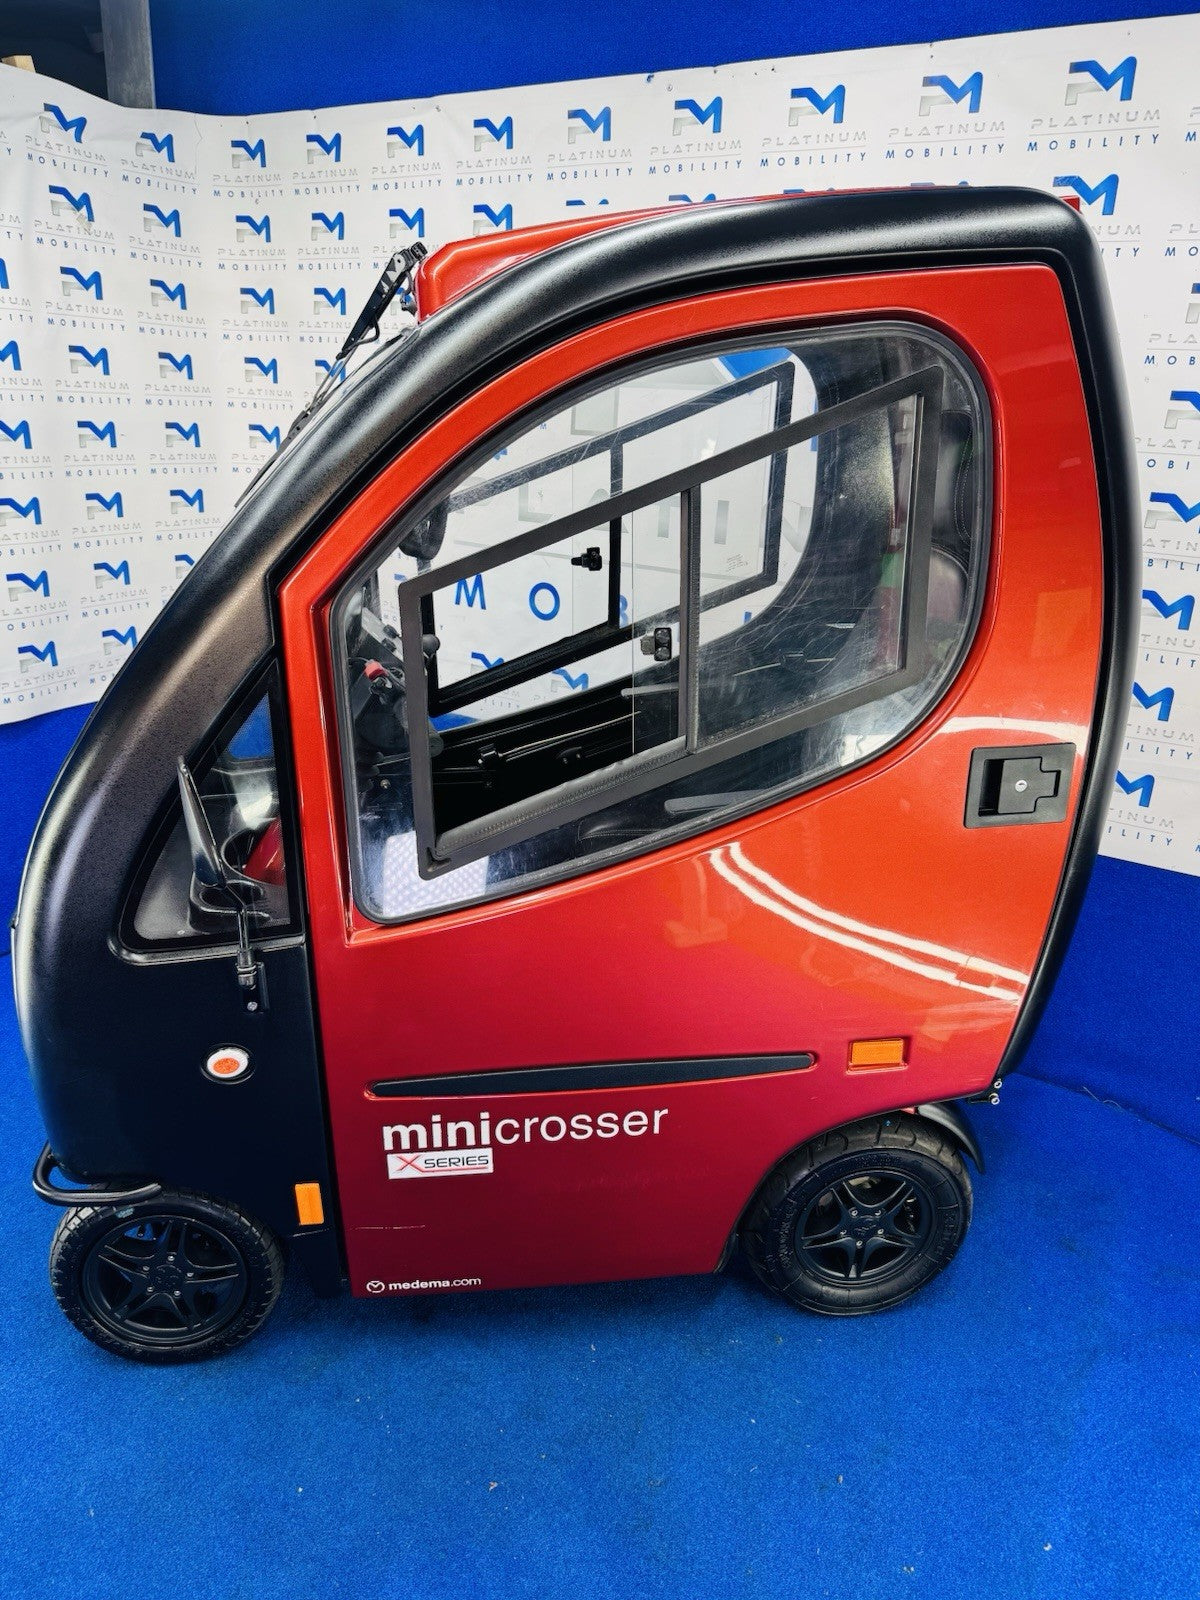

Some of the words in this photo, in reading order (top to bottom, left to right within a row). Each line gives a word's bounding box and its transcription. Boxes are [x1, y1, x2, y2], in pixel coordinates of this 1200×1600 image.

[1030, 109, 1161, 130] PLATINUM
[888, 121, 1005, 138] PLATINUM
[762, 130, 867, 147] PLATINUM
[1026, 134, 1160, 152] MOBILITY
[650, 139, 742, 155] PLATINUM
[886, 144, 1005, 158] MOBILITY
[28, 153, 108, 178] MOBILITY
[760, 152, 867, 167] MOBILITY
[546, 167, 633, 181] MOBILITY
[648, 160, 743, 175] MOBILITY
[122, 174, 197, 194] MOBILITY
[372, 179, 442, 191] MOBILITY
[456, 173, 533, 186] MOBILITY
[213, 190, 284, 198] MOBILITY
[294, 184, 360, 196] MOBILITY
[36, 237, 116, 255] MOBILITY
[130, 252, 203, 268] MOBILITY
[298, 262, 362, 271] MOBILITY
[48, 318, 126, 332] MOBILITY
[299, 320, 351, 329] PLATINU
[138, 326, 208, 339] MOBILITY
[222, 334, 291, 342] MOBILITY
[56, 395, 132, 404] MOBILITY
[145, 400, 214, 408] MOBILITY
[228, 401, 295, 411] MOBILITY
[0, 471, 54, 480] BILITY
[66, 468, 138, 477] MOBILITY
[150, 466, 219, 474] MOBILITY
[0, 529, 60, 541] ATINUM
[156, 531, 214, 542] MOBILIT
[74, 536, 144, 550] MOBILITY
[0, 544, 62, 557] BILITY
[2, 600, 68, 616] LATINUM
[82, 602, 150, 618] MOBILITY
[7, 614, 70, 631] OBILITY
[4, 681, 78, 705] MOBILITY
[382, 1107, 669, 1151] minicrosser
[396, 1154, 425, 1172] X
[424, 1155, 489, 1169] SERIES
[388, 1277, 482, 1291] medema.com
